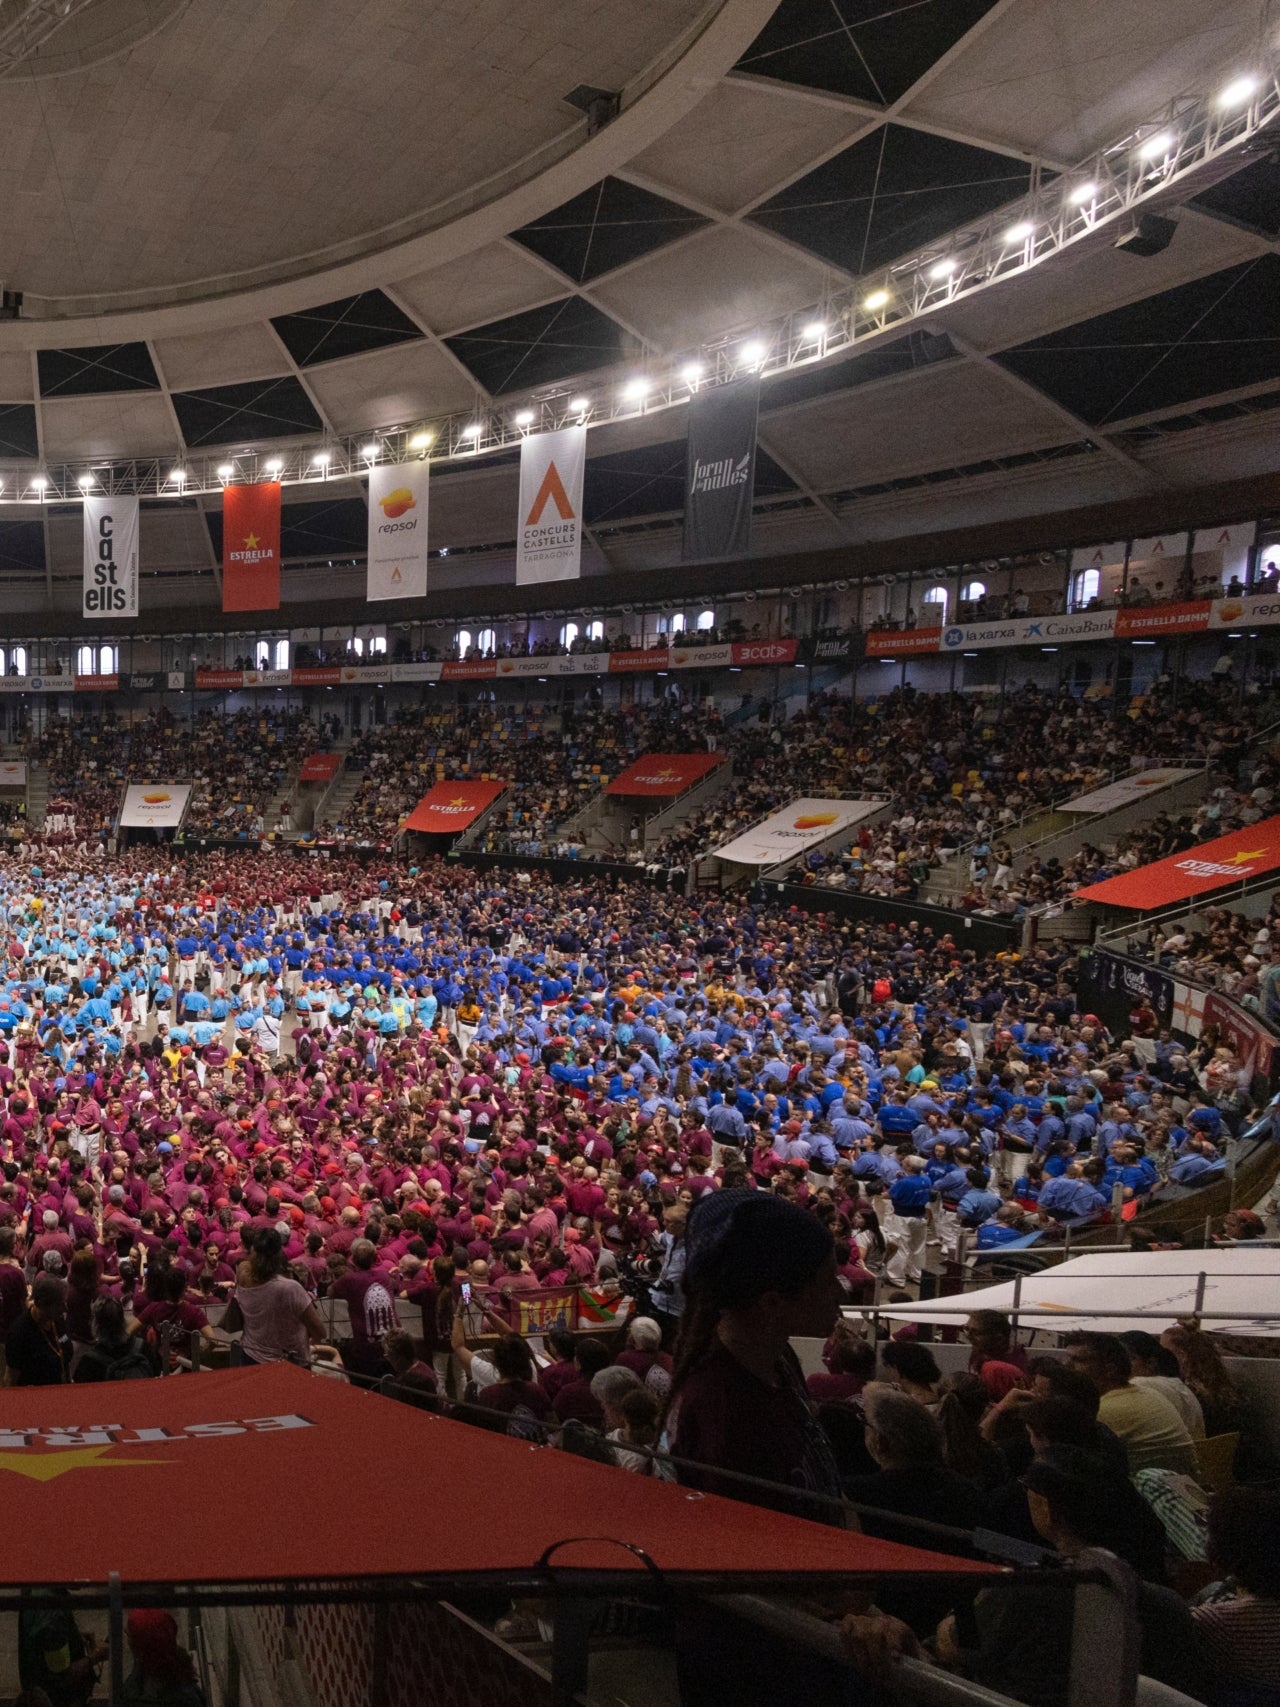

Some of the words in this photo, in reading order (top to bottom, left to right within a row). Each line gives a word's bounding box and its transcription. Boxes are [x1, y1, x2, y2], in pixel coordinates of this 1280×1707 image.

[378, 519, 418, 534] repsol
[524, 523, 576, 539] CONCURS
[523, 533, 575, 549] CASTELLS
[230, 549, 273, 561] ESTRELLA
[524, 550, 574, 563] TARRAGONA
[1130, 616, 1176, 628] ESTRELLA
[1177, 612, 1209, 624] DAMM
[1046, 617, 1115, 637] CaixaBank
[966, 630, 976, 641] la
[978, 627, 1015, 639] xarxa
[879, 638, 915, 648] ESTRELLA
[693, 651, 728, 661] repsol
[740, 644, 776, 660] 3cat
[518, 662, 550, 672] repsol
[361, 671, 389, 680] repsol
[1, 680, 26, 688] repsol
[429, 804, 476, 812] ESTRELLA
[1174, 859, 1256, 876] ESTRELLA
